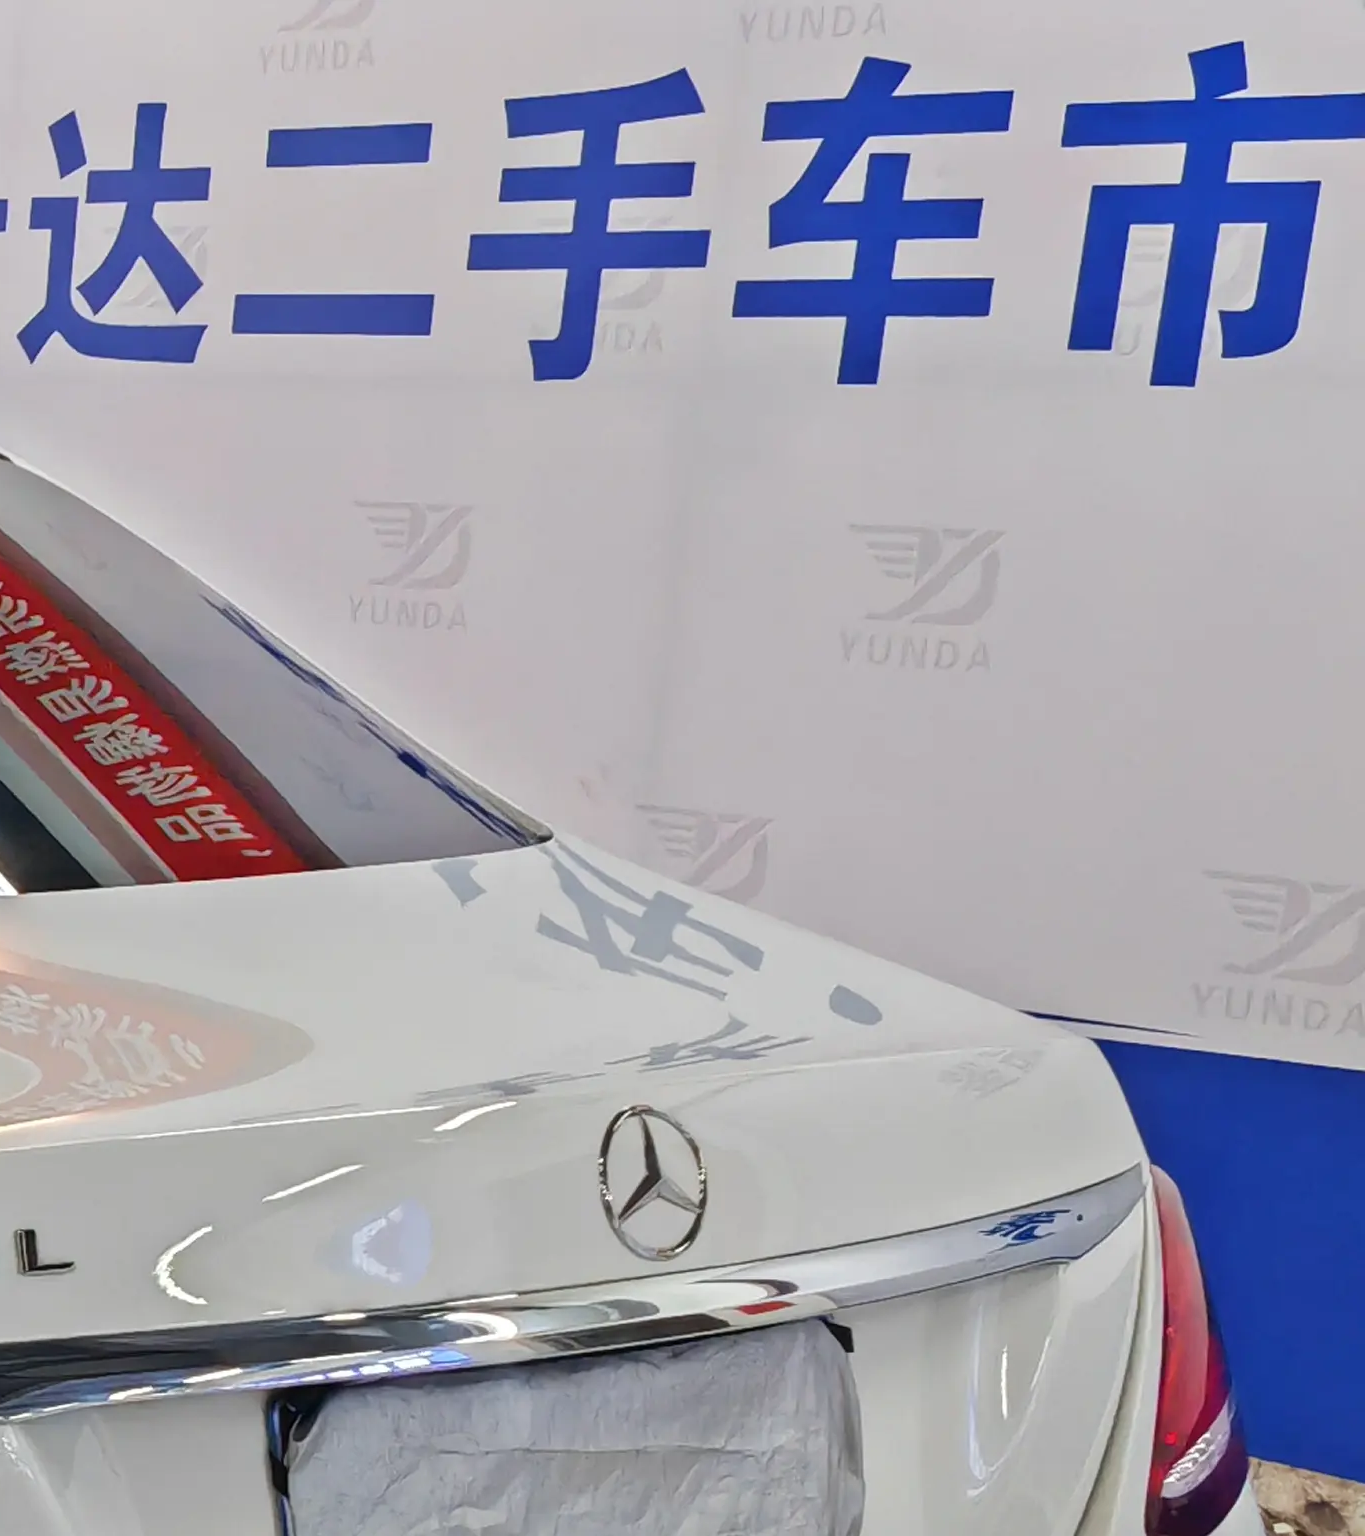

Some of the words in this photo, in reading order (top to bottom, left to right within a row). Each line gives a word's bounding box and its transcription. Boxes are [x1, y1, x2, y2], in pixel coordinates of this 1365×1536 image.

[739, 5, 887, 43] YUNDA
[258, 39, 376, 74] YUNDA
[349, 595, 468, 632] YUNDA
[838, 627, 993, 672] YUNDA
[1189, 981, 1365, 1039] YUNDA
[13, 1228, 76, 1277] L
